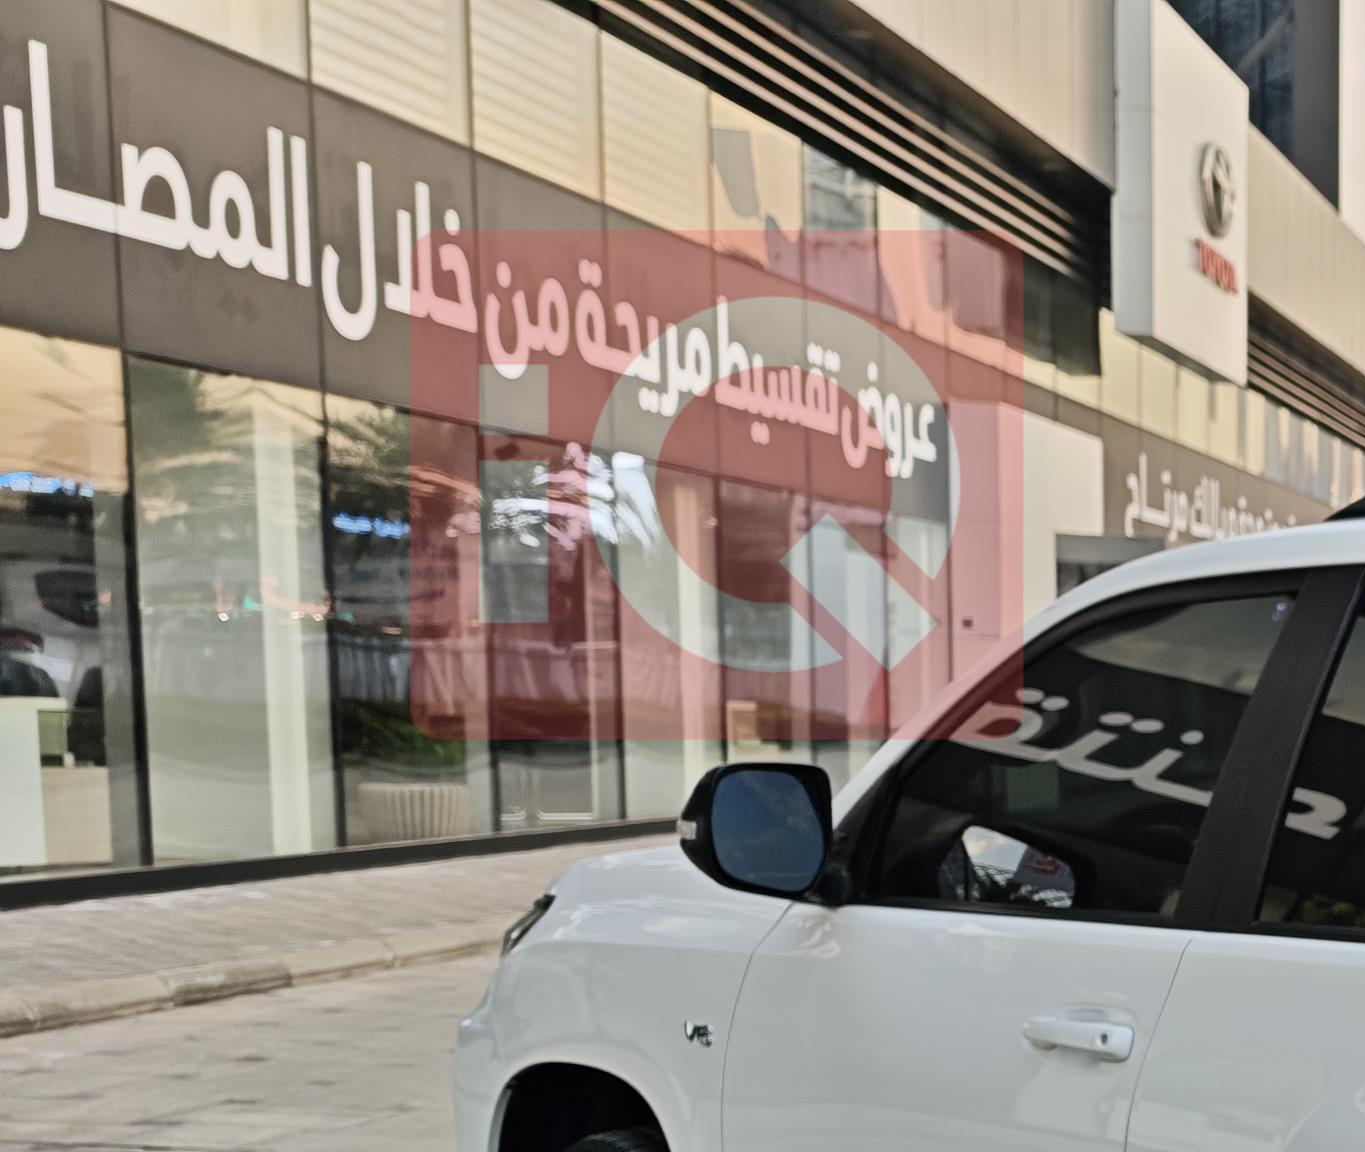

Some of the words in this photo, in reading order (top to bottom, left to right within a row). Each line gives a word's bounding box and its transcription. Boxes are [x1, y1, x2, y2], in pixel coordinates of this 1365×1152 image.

[320, 162, 479, 342] خلال
[485, 261, 570, 379] من
[575, 259, 712, 418] مريحة
[715, 294, 839, 445] تقسيط
[841, 361, 937, 480] عروض
